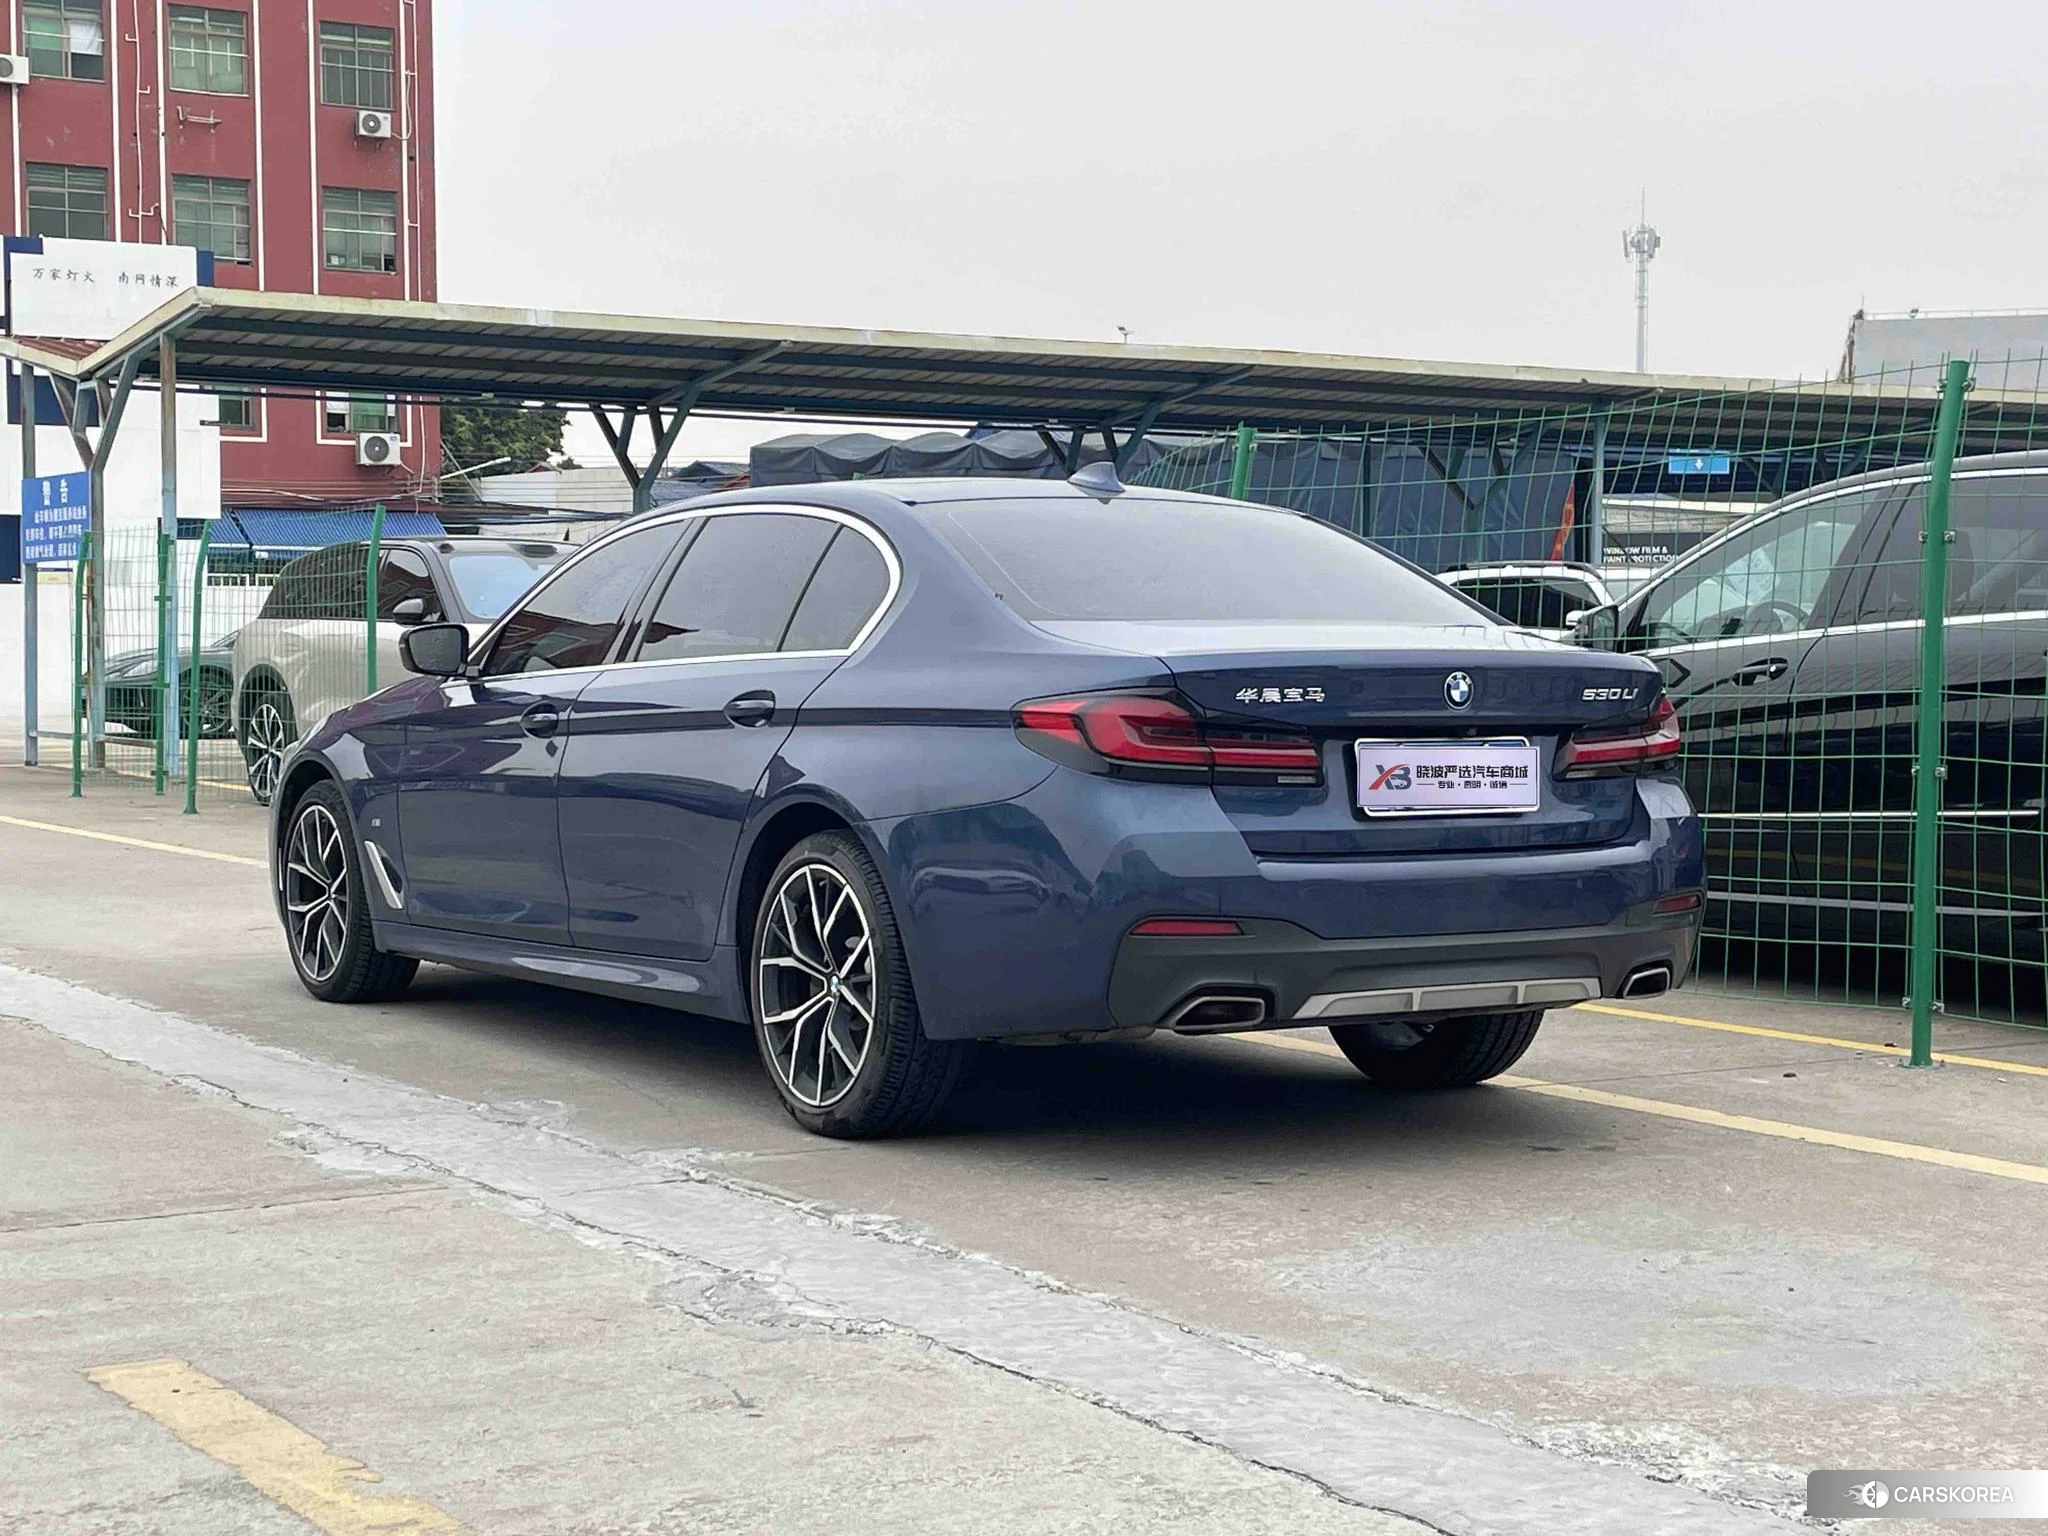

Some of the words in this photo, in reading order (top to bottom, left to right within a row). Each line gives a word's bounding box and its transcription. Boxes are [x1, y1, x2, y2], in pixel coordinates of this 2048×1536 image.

[1641, 545, 1660, 555] FILM
[1603, 555, 1627, 564] PAINT
[1235, 687, 1326, 704] 华晨宝马
[1416, 764, 1529, 779] 晓波严选汽车商城
